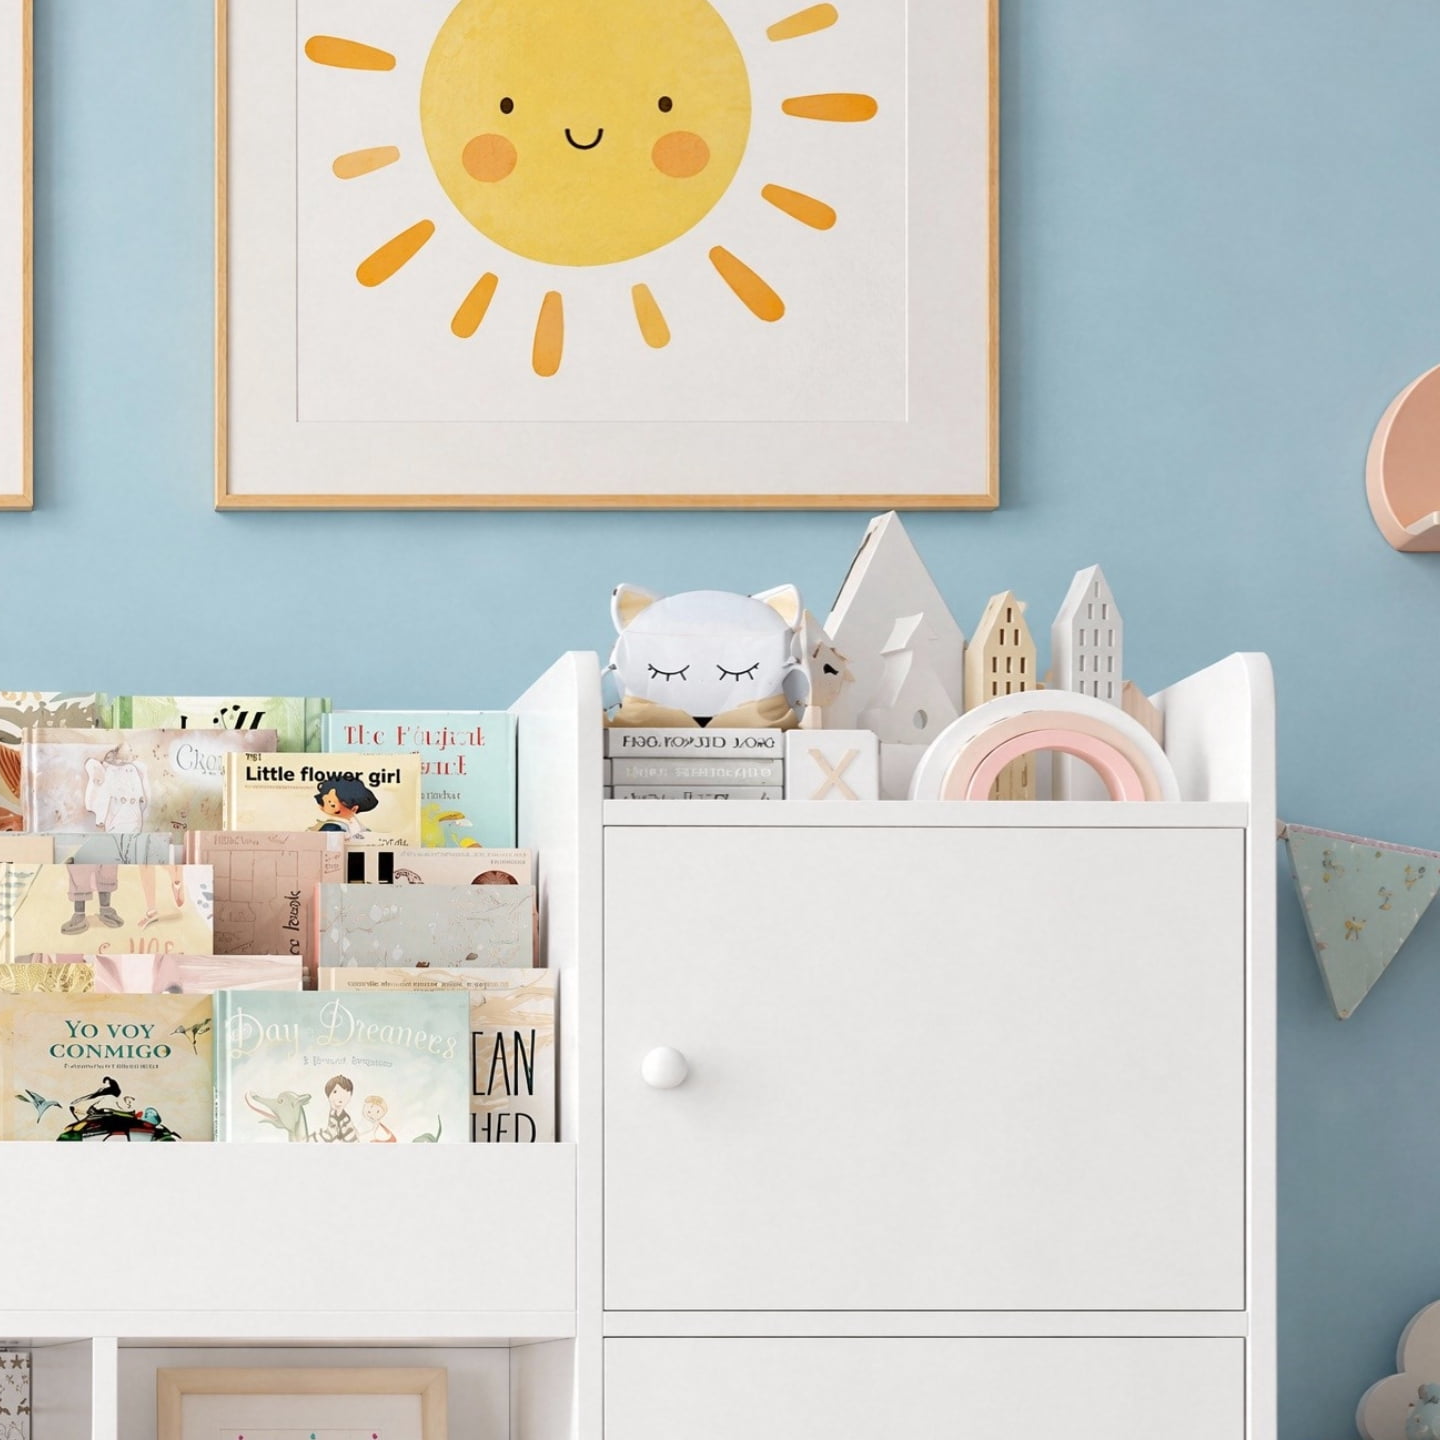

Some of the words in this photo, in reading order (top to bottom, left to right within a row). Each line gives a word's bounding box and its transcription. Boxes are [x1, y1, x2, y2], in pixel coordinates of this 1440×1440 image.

[246, 766, 296, 782] Little
[301, 766, 363, 783] flower
[369, 768, 401, 788] girl
[228, 1007, 299, 1058] Day
[49, 1043, 172, 1059] CONMIGO
